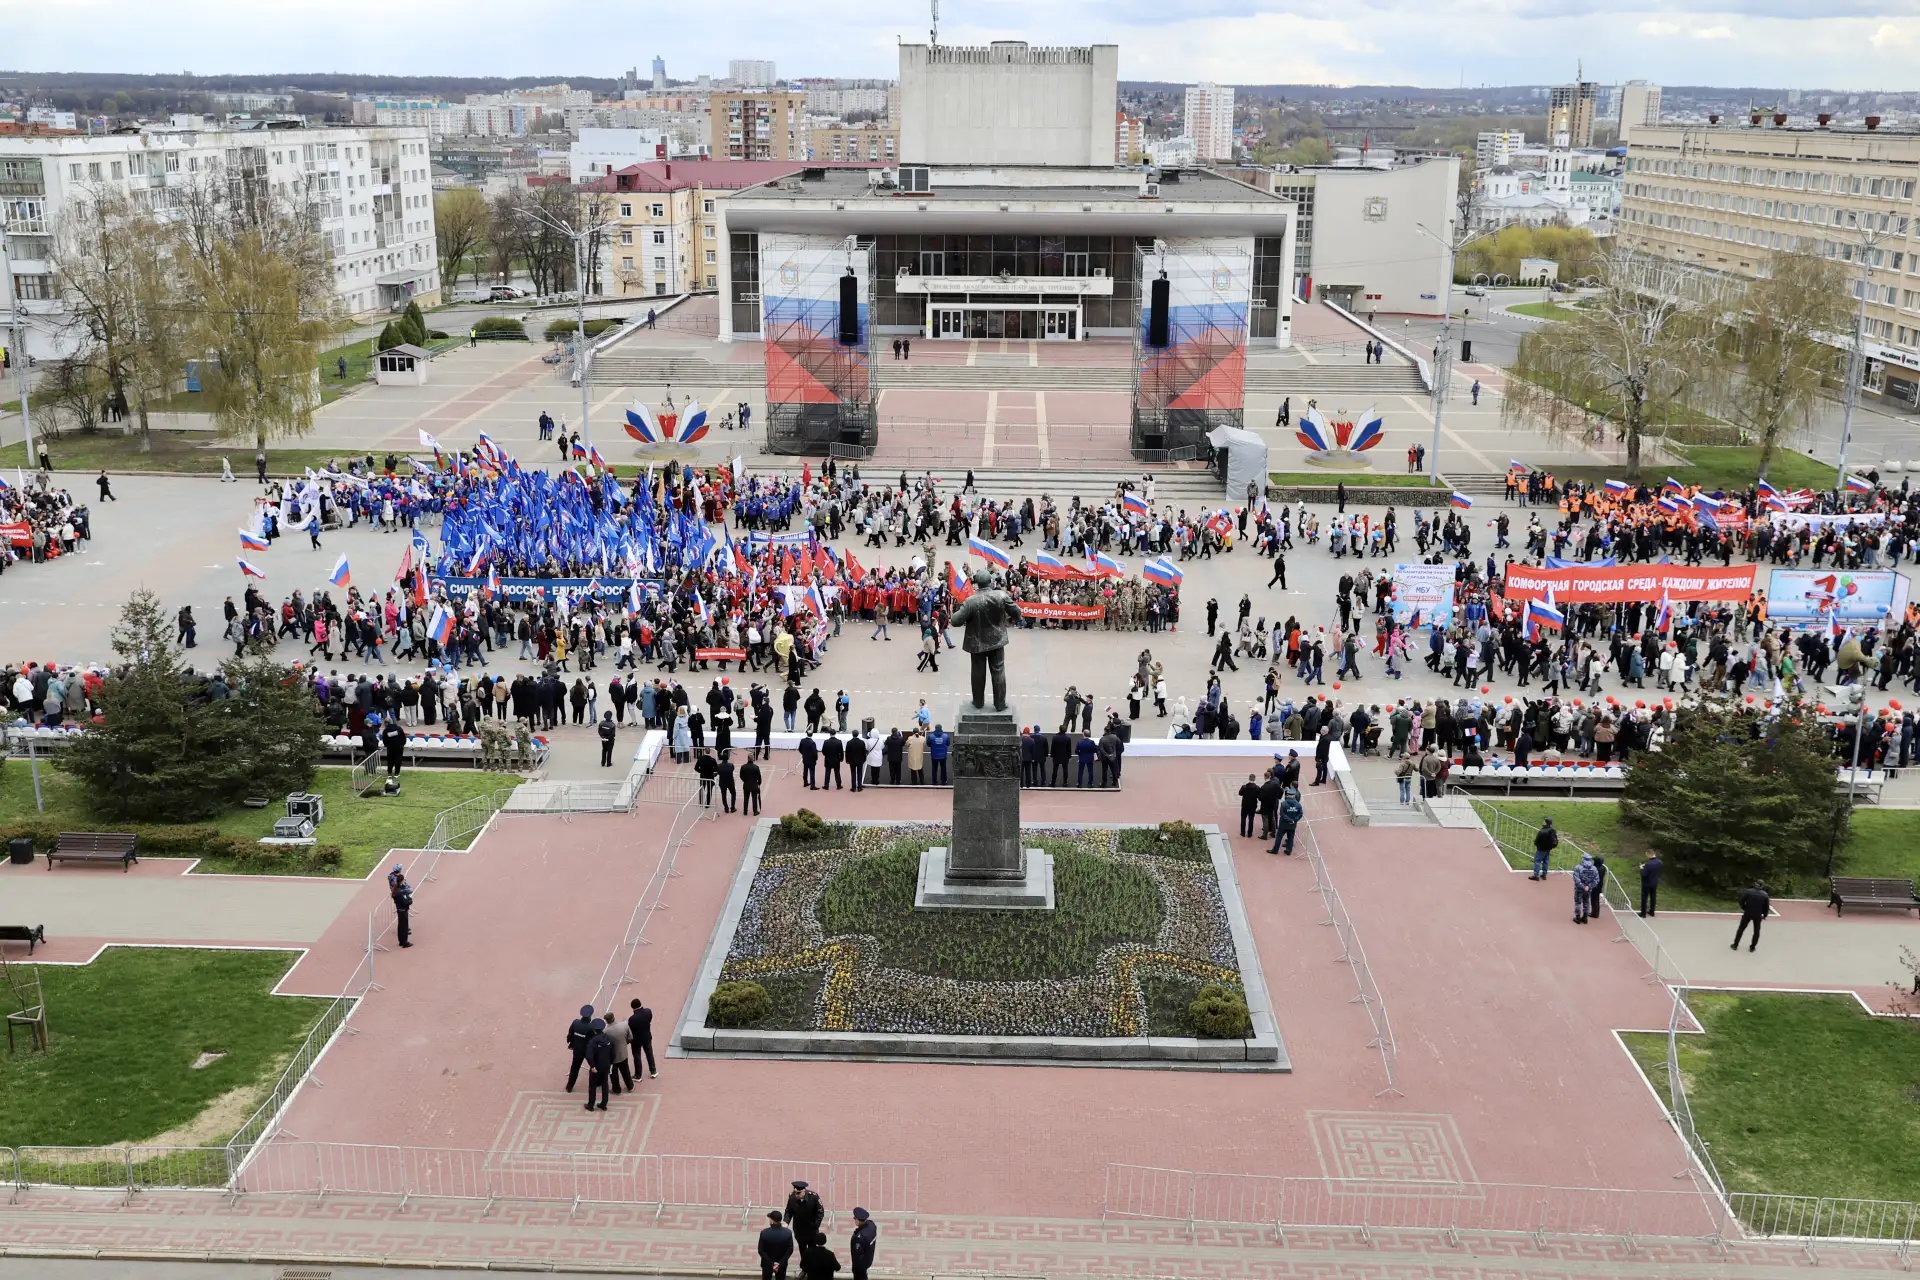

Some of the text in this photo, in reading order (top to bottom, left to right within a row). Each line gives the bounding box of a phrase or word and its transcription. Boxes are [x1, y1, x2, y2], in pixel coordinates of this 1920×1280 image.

[1508, 576, 1570, 592] КОМФОРТНАЯ
[1572, 579, 1625, 593] ГОРОДСКАЯ
[1627, 578, 1657, 592] СРЕДА
[1662, 577, 1705, 591] КАЖДОМУ
[1707, 577, 1752, 590] ЖИТЕЛЮ!
[1044, 607, 1067, 617] будет
[1077, 609, 1101, 617] нами!
